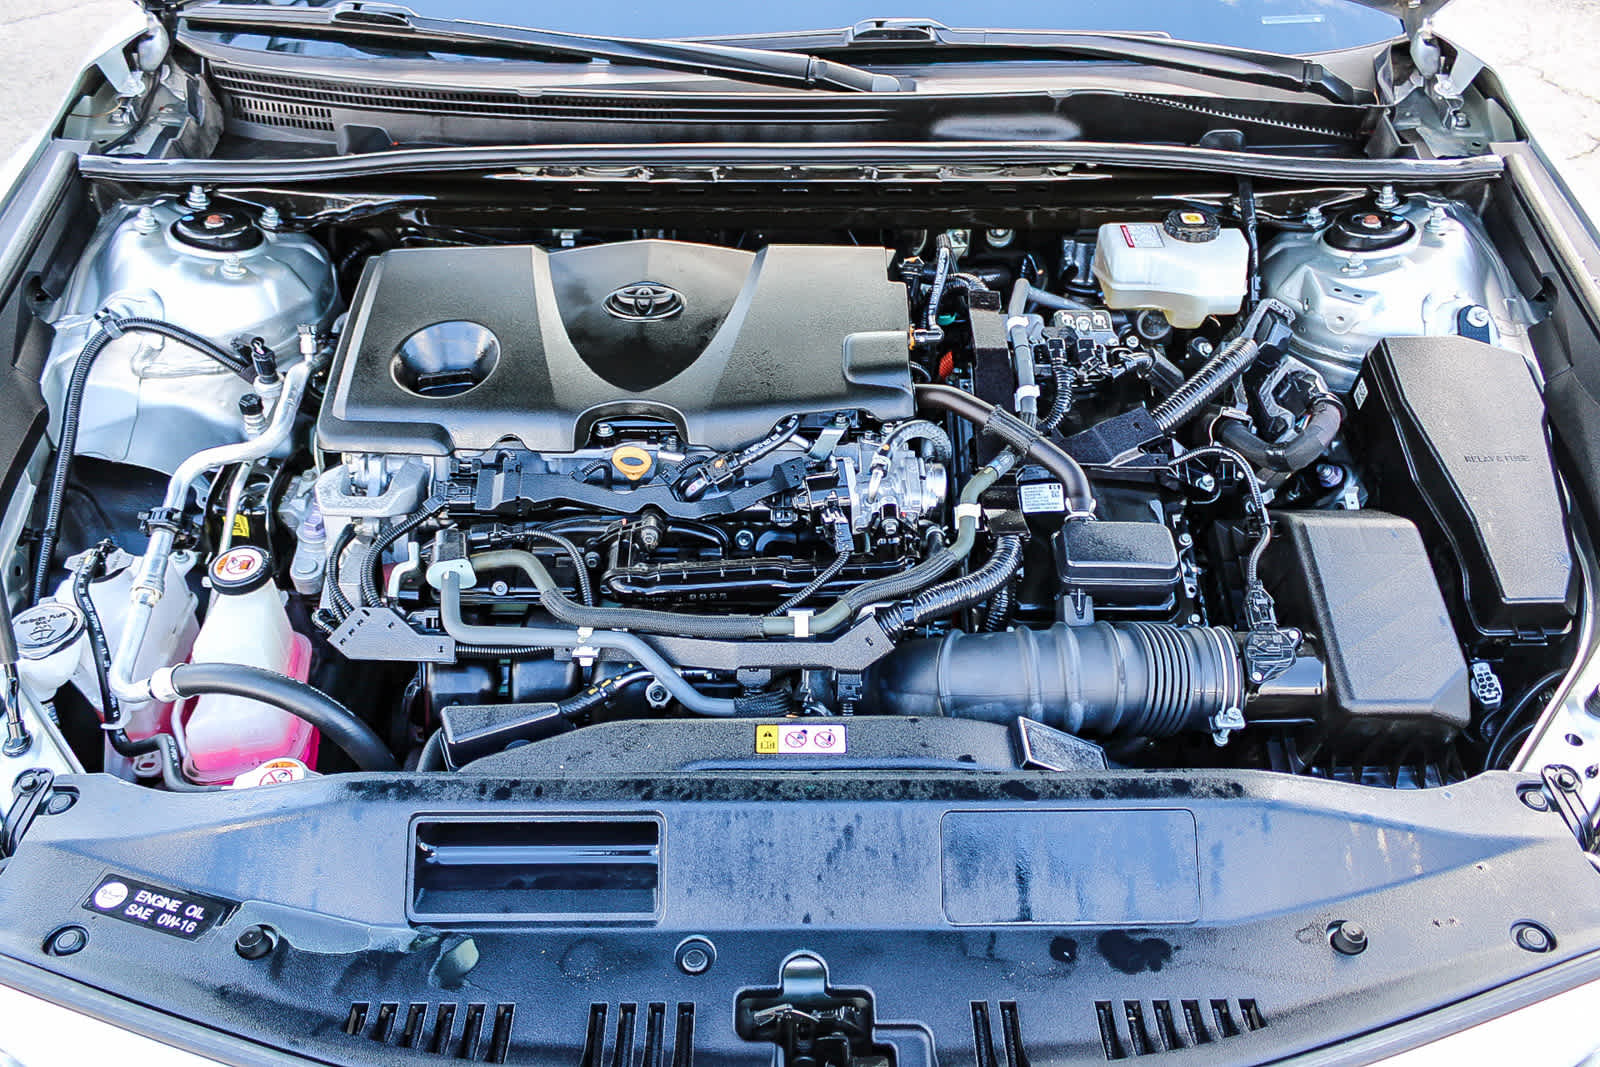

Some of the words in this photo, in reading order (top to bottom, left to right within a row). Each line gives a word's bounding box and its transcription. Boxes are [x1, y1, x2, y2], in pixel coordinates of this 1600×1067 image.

[125, 903, 155, 921] SAE
[157, 912, 198, 934] 0W-16
[135, 889, 183, 912] ENGINE
[185, 904, 204, 920] OIL
